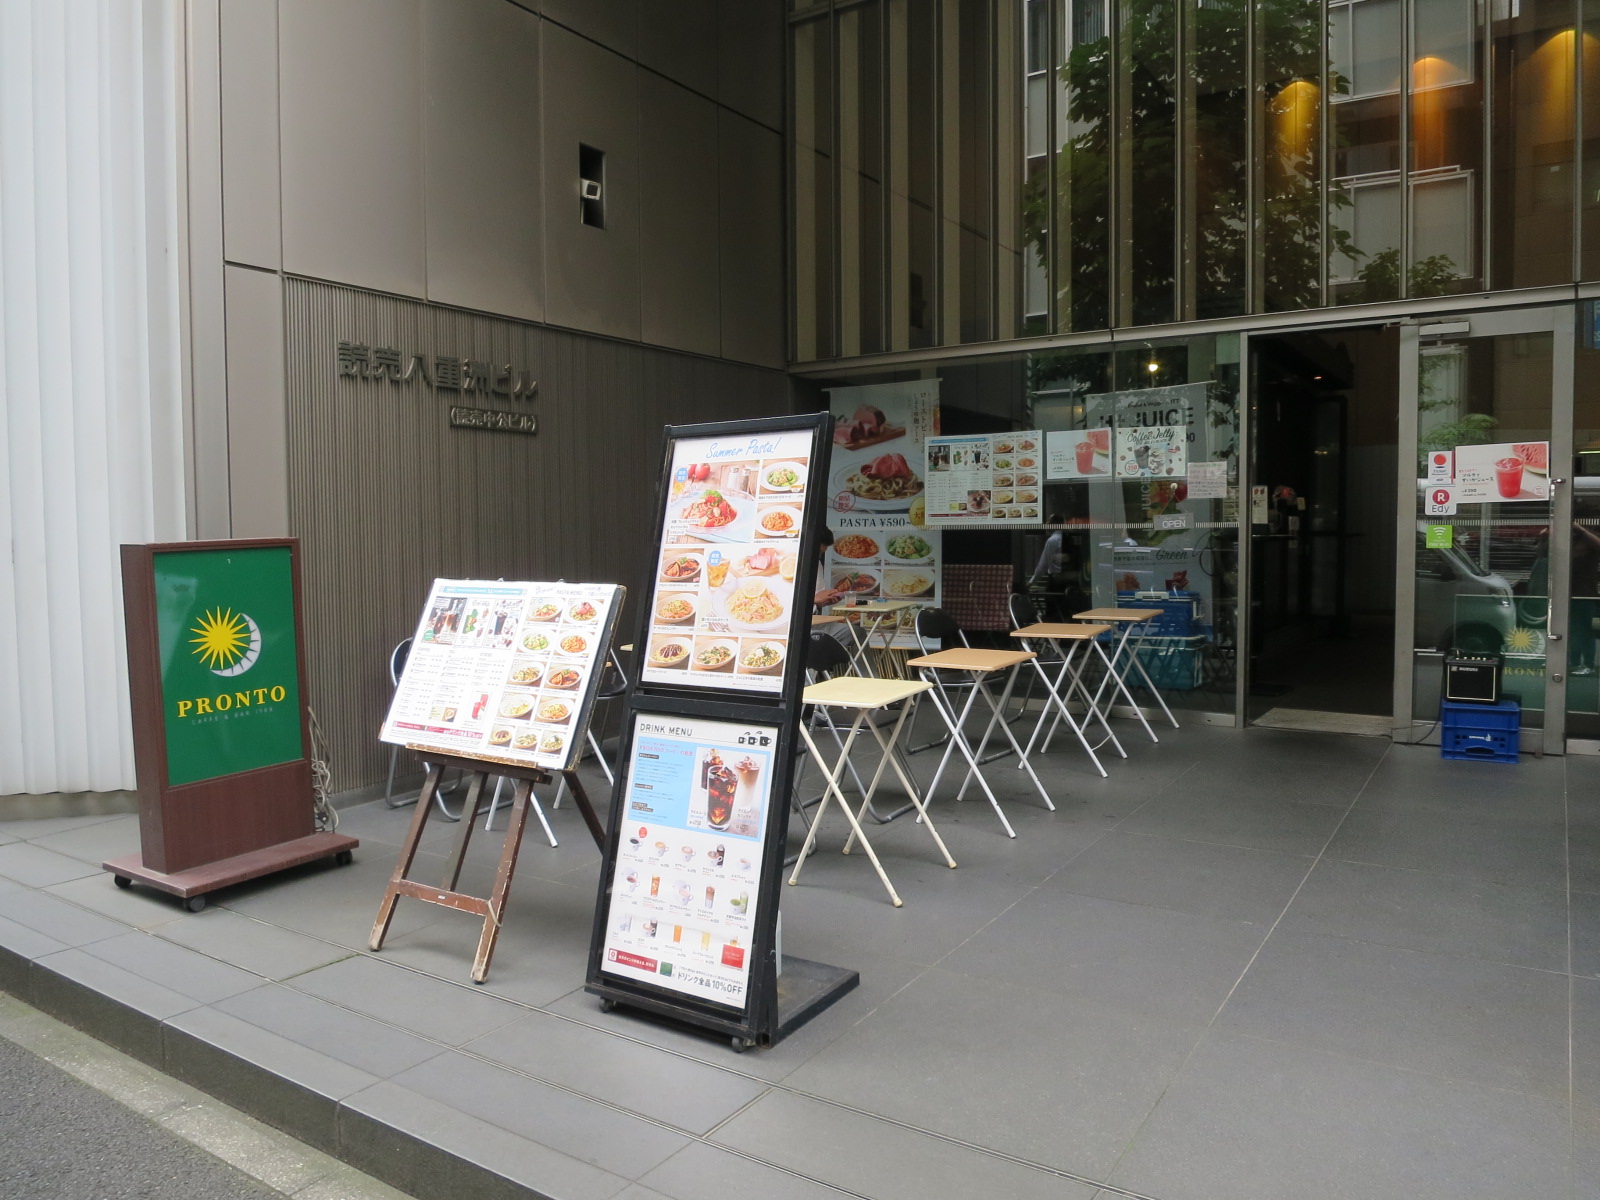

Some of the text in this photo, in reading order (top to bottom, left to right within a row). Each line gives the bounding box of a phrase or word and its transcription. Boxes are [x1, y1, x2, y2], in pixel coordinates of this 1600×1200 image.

[338, 340, 538, 398] 読売八重洲ビル
[1126, 428, 1176, 445] Coffee Jelly
[705, 436, 782, 459] Summer Pasta!
[1431, 504, 1450, 514] Edy
[840, 518, 876, 528] PASTA
[1162, 519, 1186, 529] OPEN
[1156, 550, 1188, 560] Green
[1504, 666, 1546, 678] RONT
[177, 685, 286, 718] PRONTO
[640, 723, 693, 736] DRINK MENU
